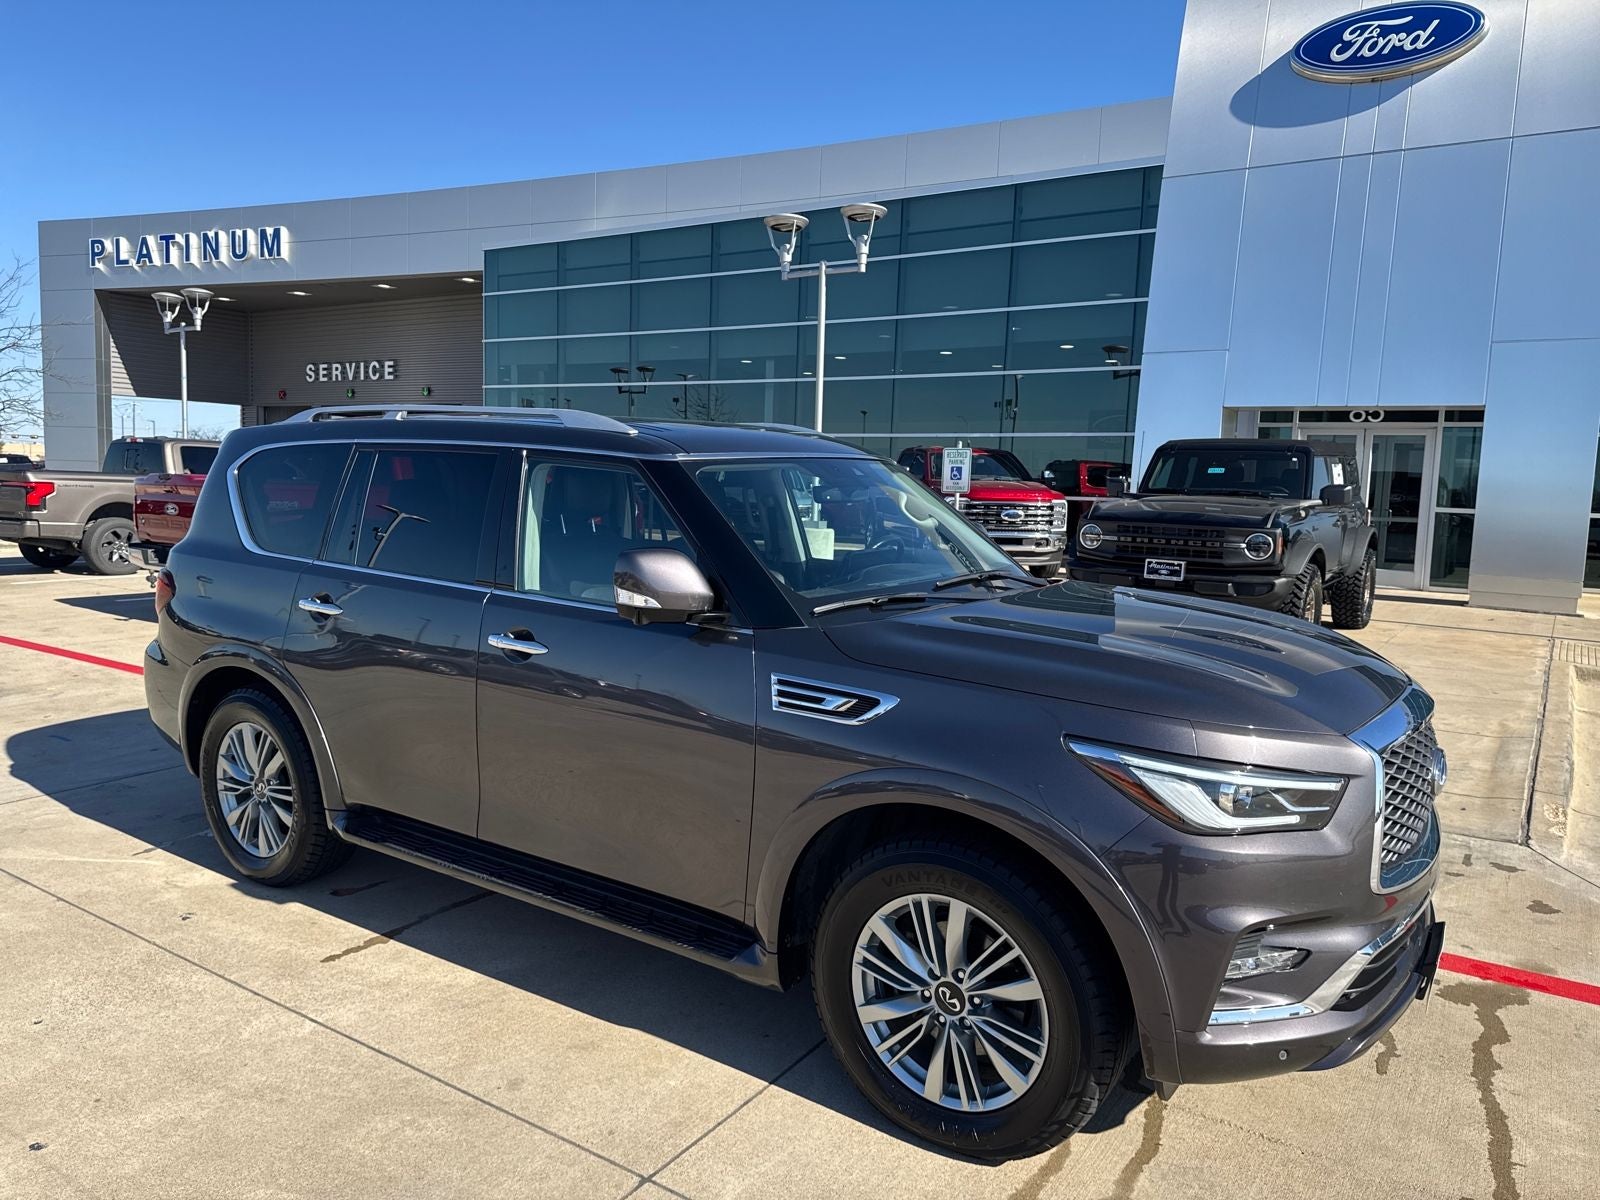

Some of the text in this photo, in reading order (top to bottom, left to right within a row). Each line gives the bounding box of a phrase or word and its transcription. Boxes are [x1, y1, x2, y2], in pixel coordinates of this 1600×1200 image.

[1330, 15, 1440, 62] Ford
[89, 226, 281, 268] PLATINUM
[305, 360, 395, 382] SERVICE
[1120, 536, 1220, 547] BRONCO
